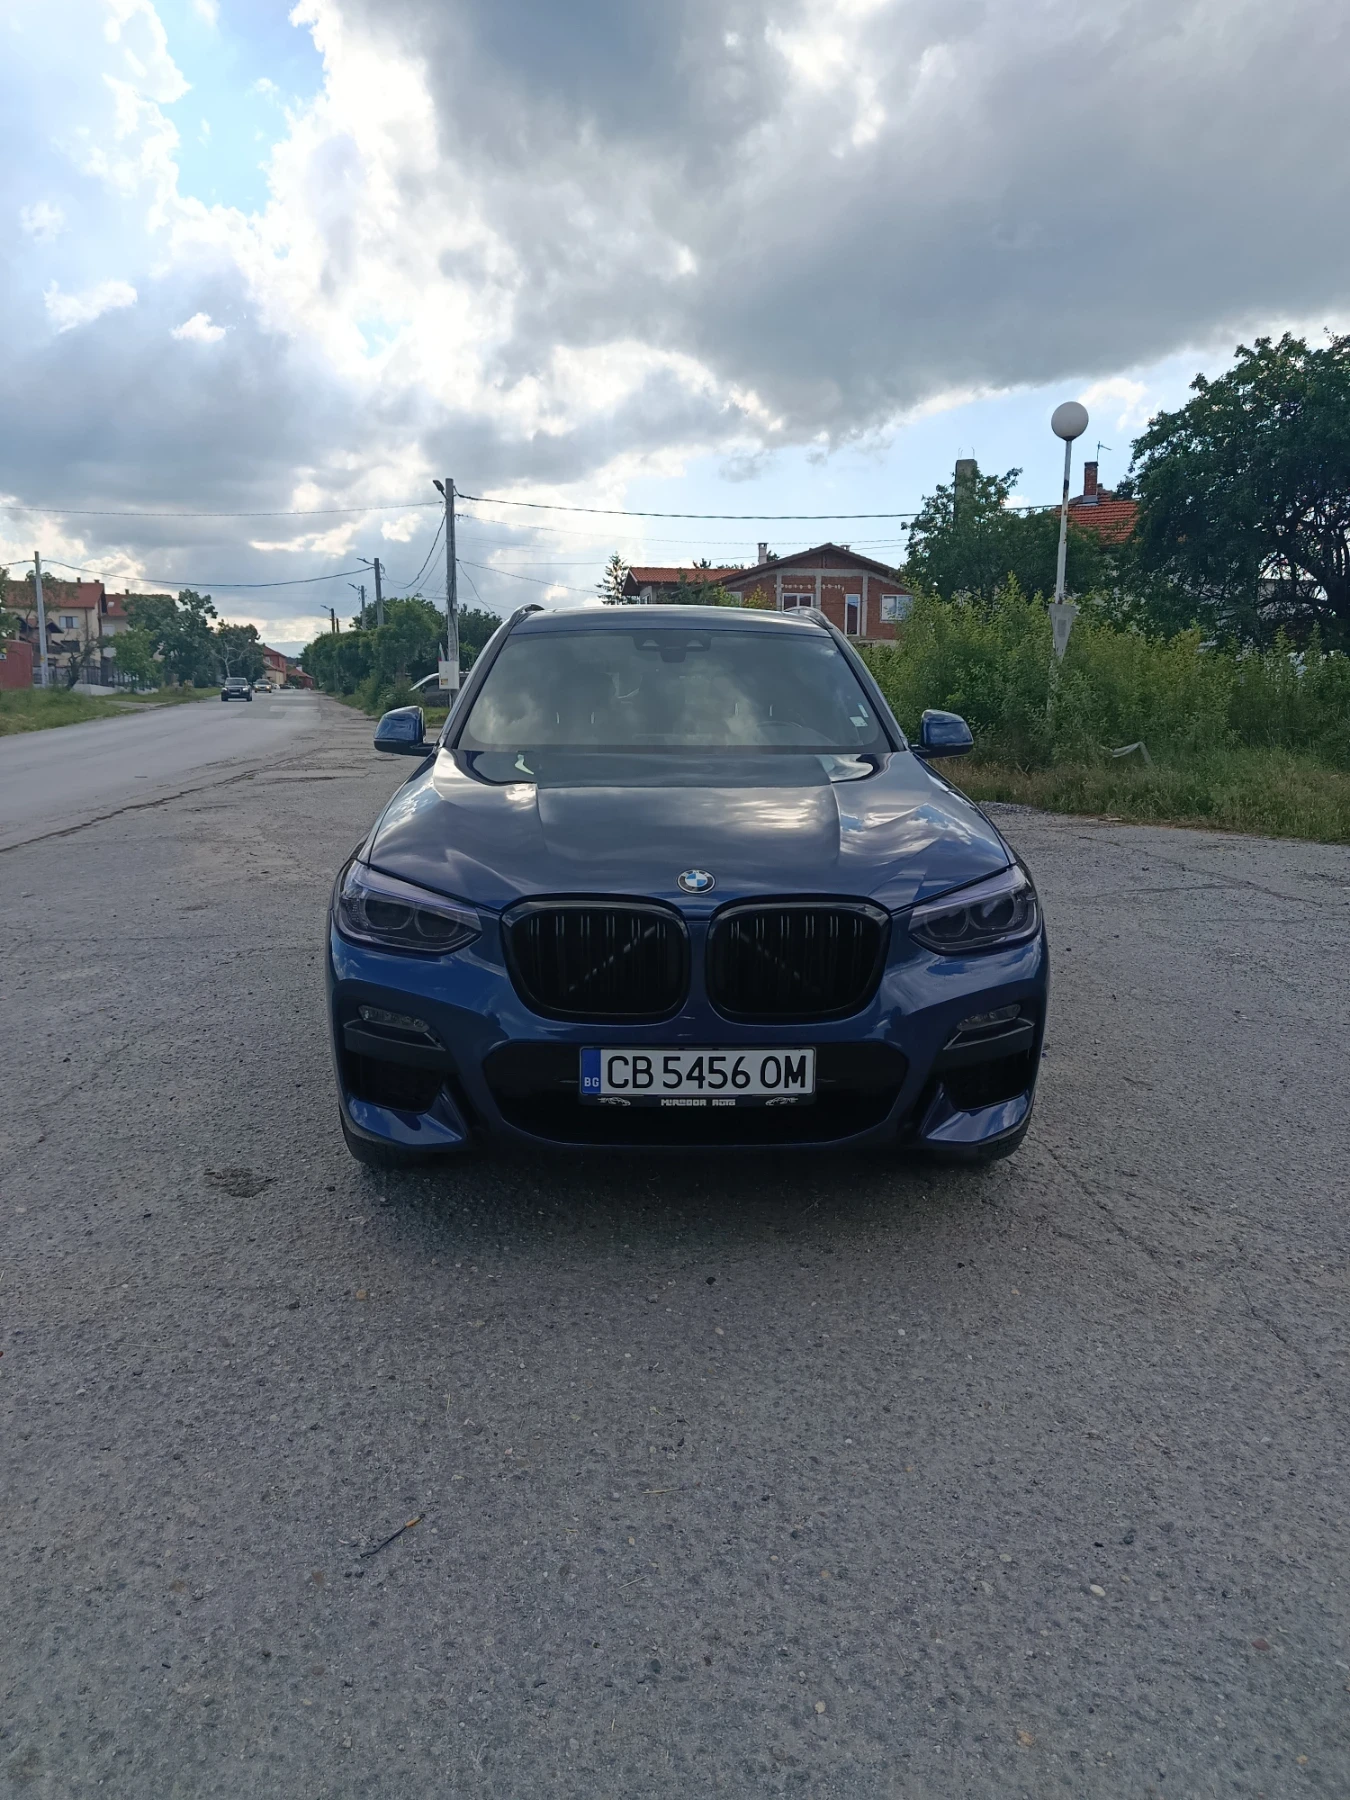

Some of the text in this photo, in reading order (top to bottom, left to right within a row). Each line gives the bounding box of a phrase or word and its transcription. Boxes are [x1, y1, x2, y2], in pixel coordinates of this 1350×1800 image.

[584, 1077, 600, 1088] BG
[607, 1055, 806, 1089] CB 5456 OM
